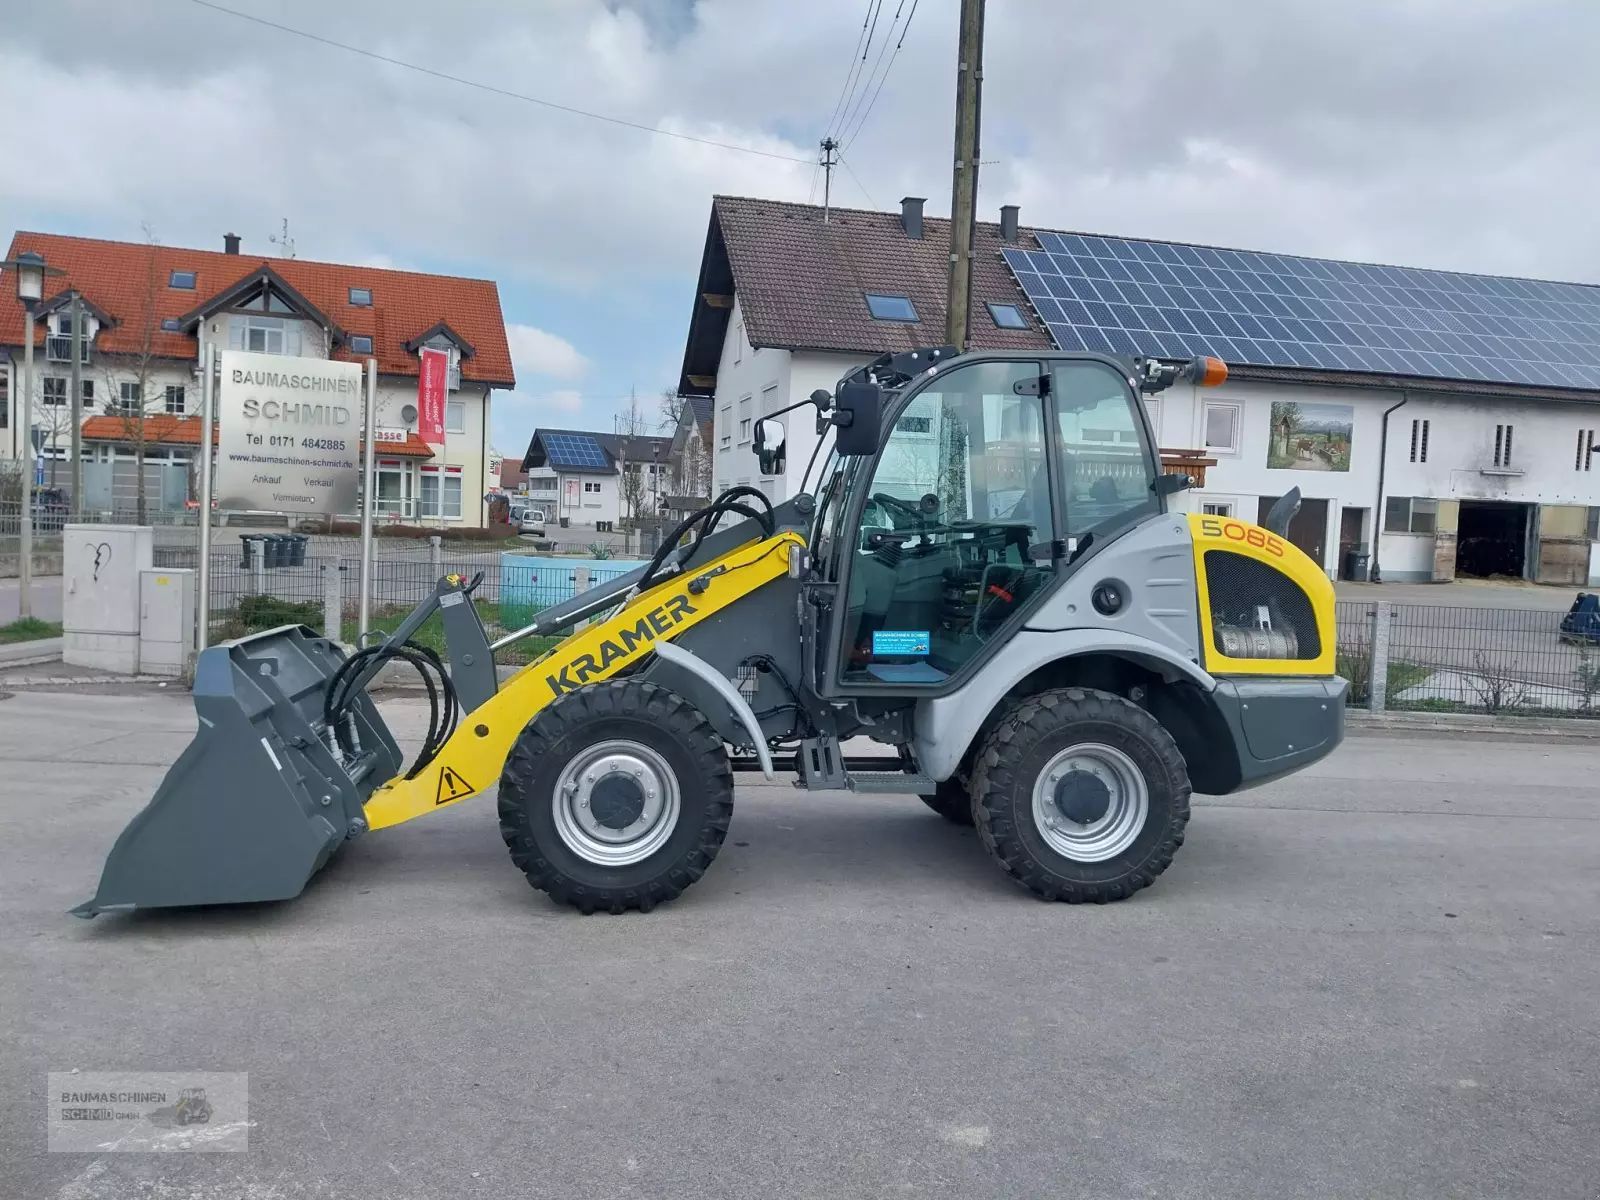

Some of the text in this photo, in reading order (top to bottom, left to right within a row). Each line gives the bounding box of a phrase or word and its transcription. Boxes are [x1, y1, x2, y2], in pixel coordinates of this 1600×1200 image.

[232, 369, 358, 394] BAUMASCHINEN
[242, 399, 351, 425] SCHMID
[246, 433, 346, 450] Tel 0171 4842885
[229, 453, 353, 469] www.baumaschinen-schmid.de
[252, 473, 334, 488] Ankauf Verkauf
[272, 493, 316, 504] Vermietung
[1202, 519, 1284, 557] 5085
[545, 594, 698, 698] KRAMER
